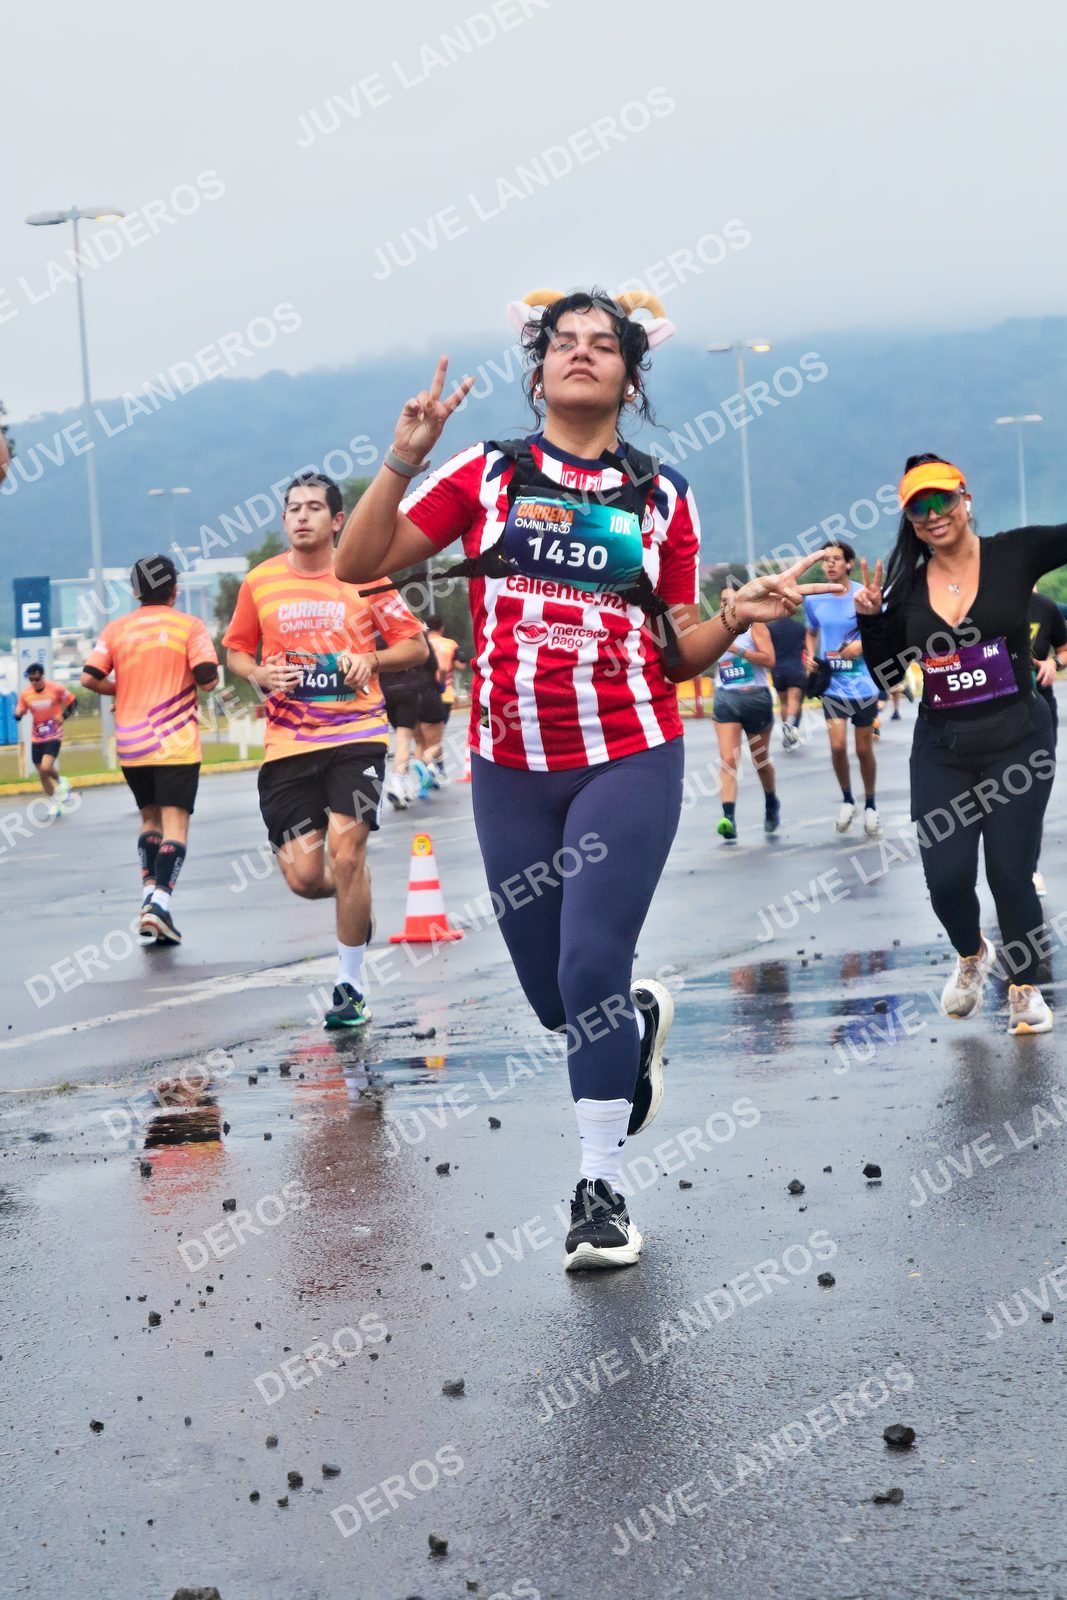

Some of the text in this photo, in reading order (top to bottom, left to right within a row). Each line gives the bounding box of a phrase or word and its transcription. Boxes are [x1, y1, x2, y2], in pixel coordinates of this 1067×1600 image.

[517, 503, 574, 522] CARRERA
[609, 515, 631, 536] 10K
[528, 537, 608, 570] 1430
[21, 602, 42, 630] E
[278, 600, 345, 621] CARRERA
[551, 636, 583, 648] pago
[553, 626, 607, 639] mercado
[299, 673, 337, 688] 1401
[947, 669, 987, 692] 599
